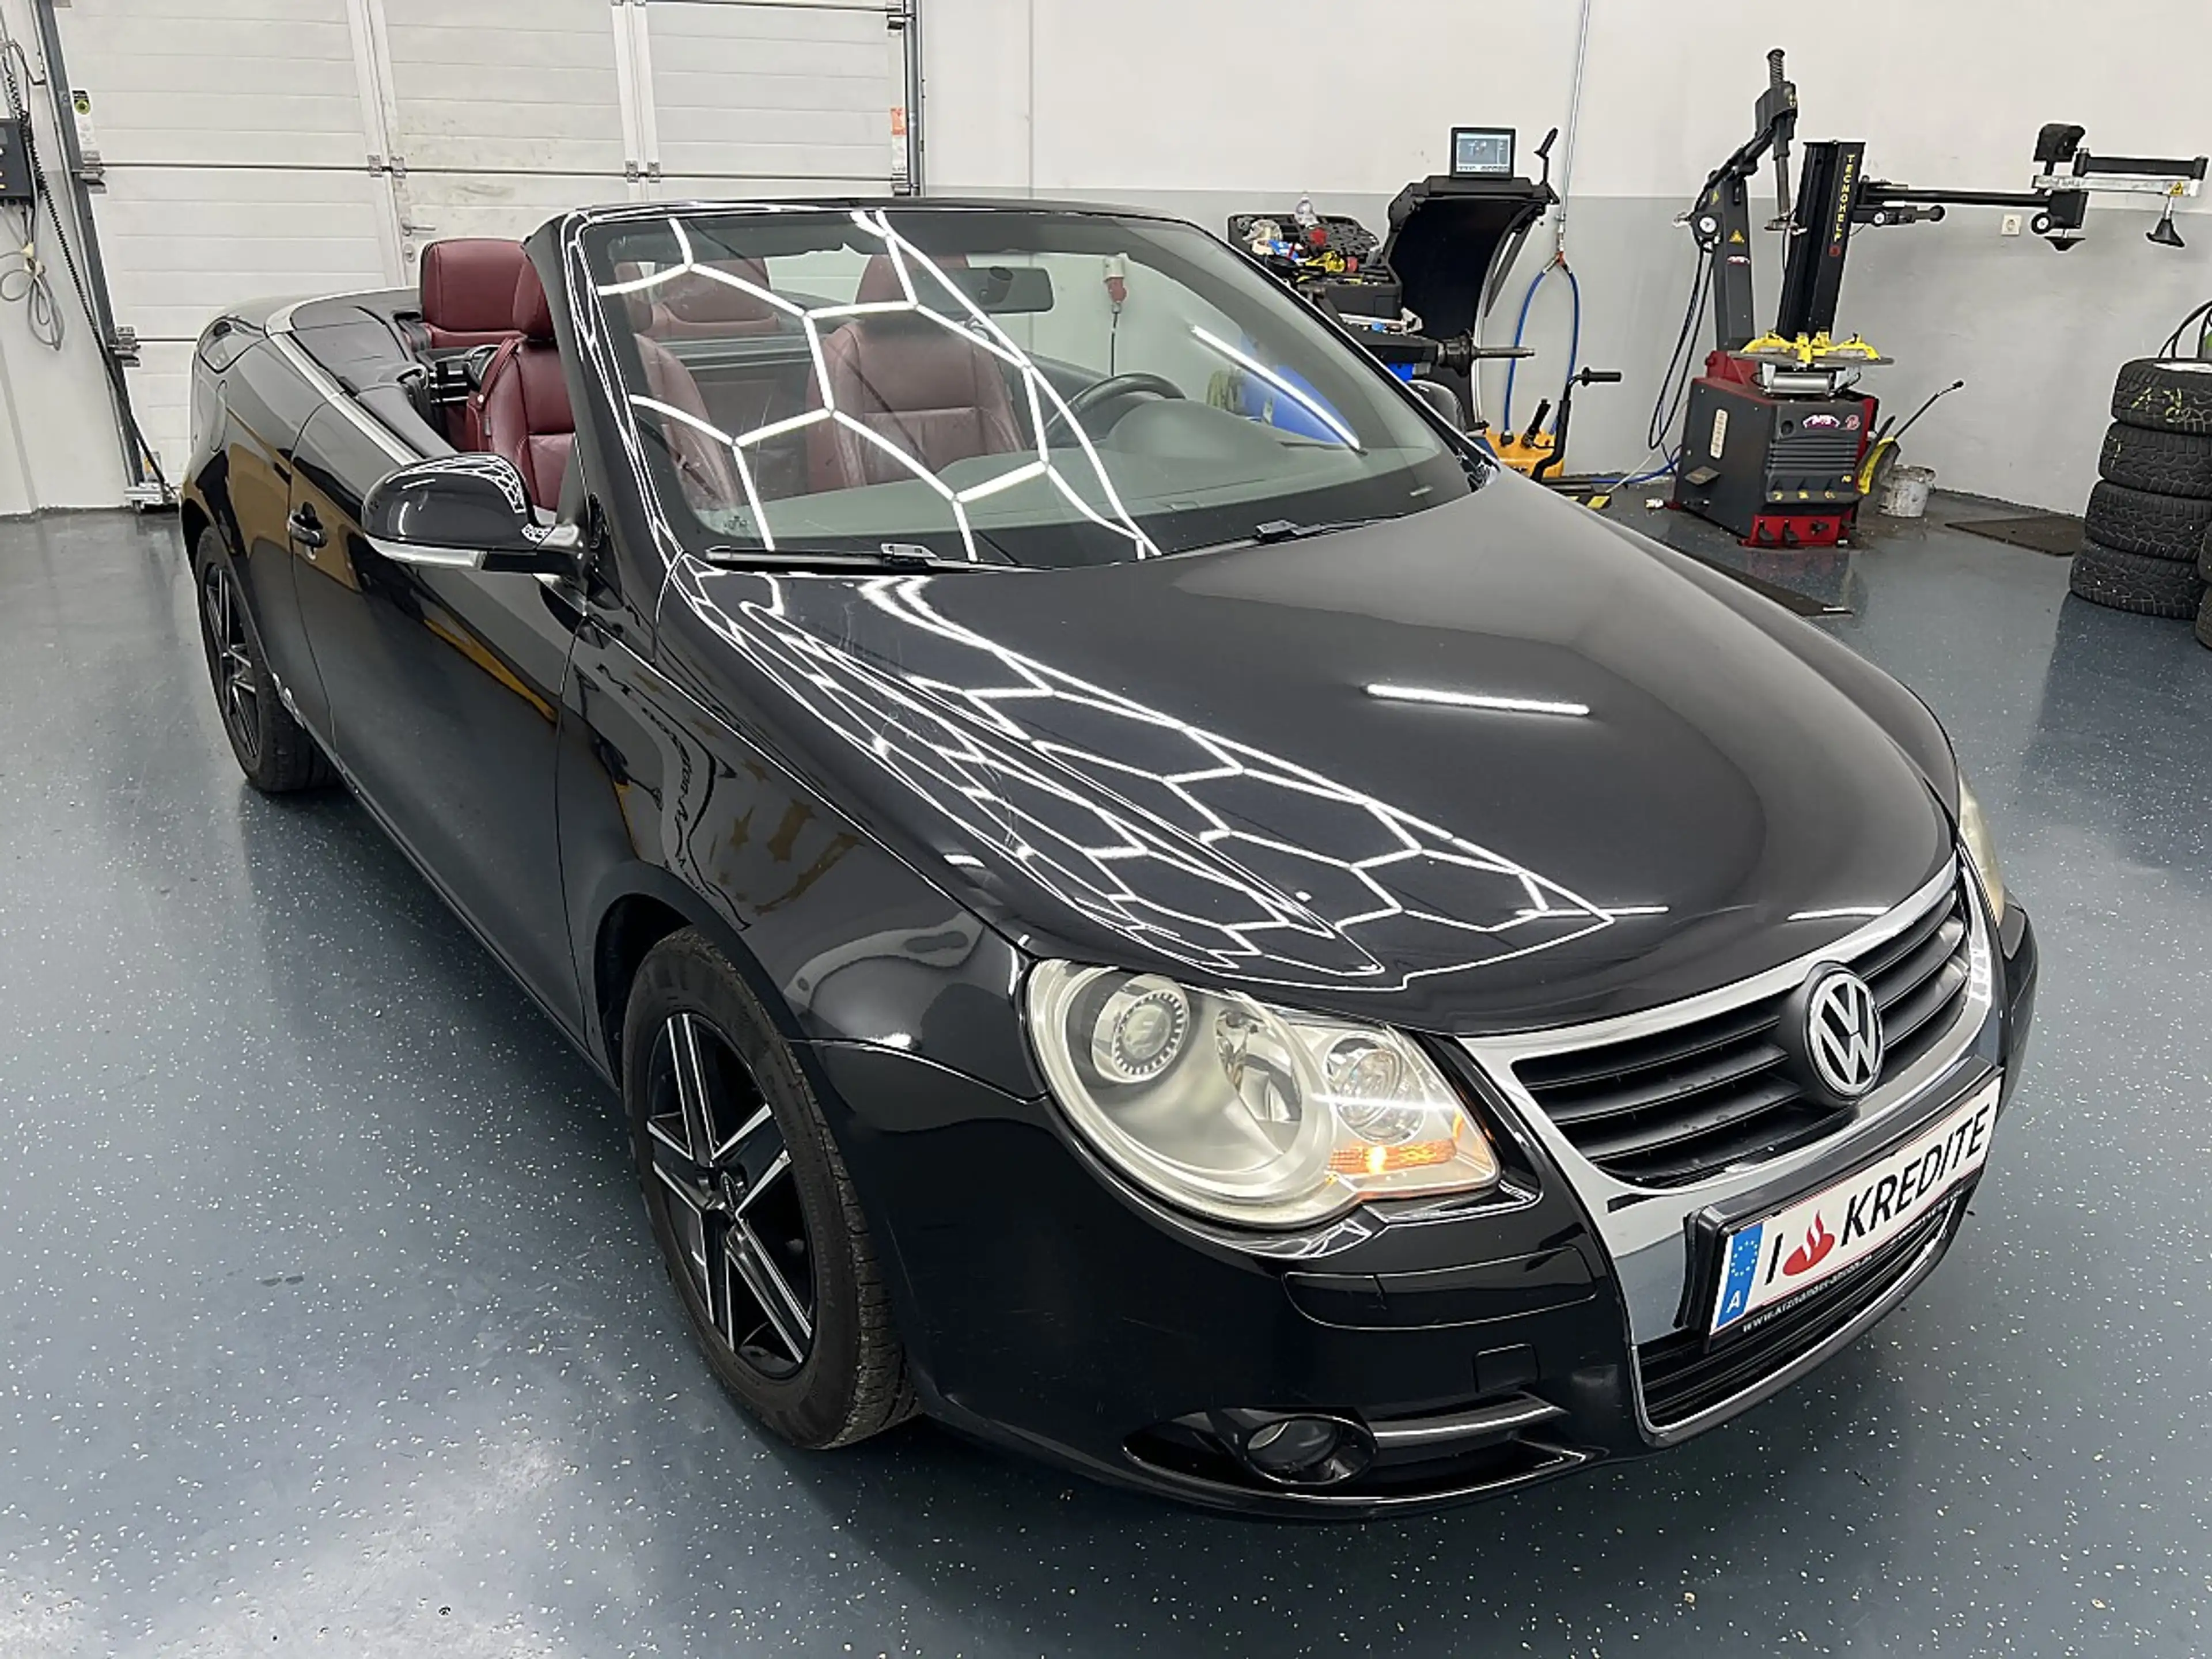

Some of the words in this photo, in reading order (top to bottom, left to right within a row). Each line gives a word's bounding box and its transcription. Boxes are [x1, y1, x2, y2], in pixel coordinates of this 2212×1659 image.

[1810, 974, 1876, 1092] VW
[1763, 1232, 1783, 1286] I
[1840, 1103, 1990, 1247] KREDITE
[1726, 1290, 1741, 1314] A
